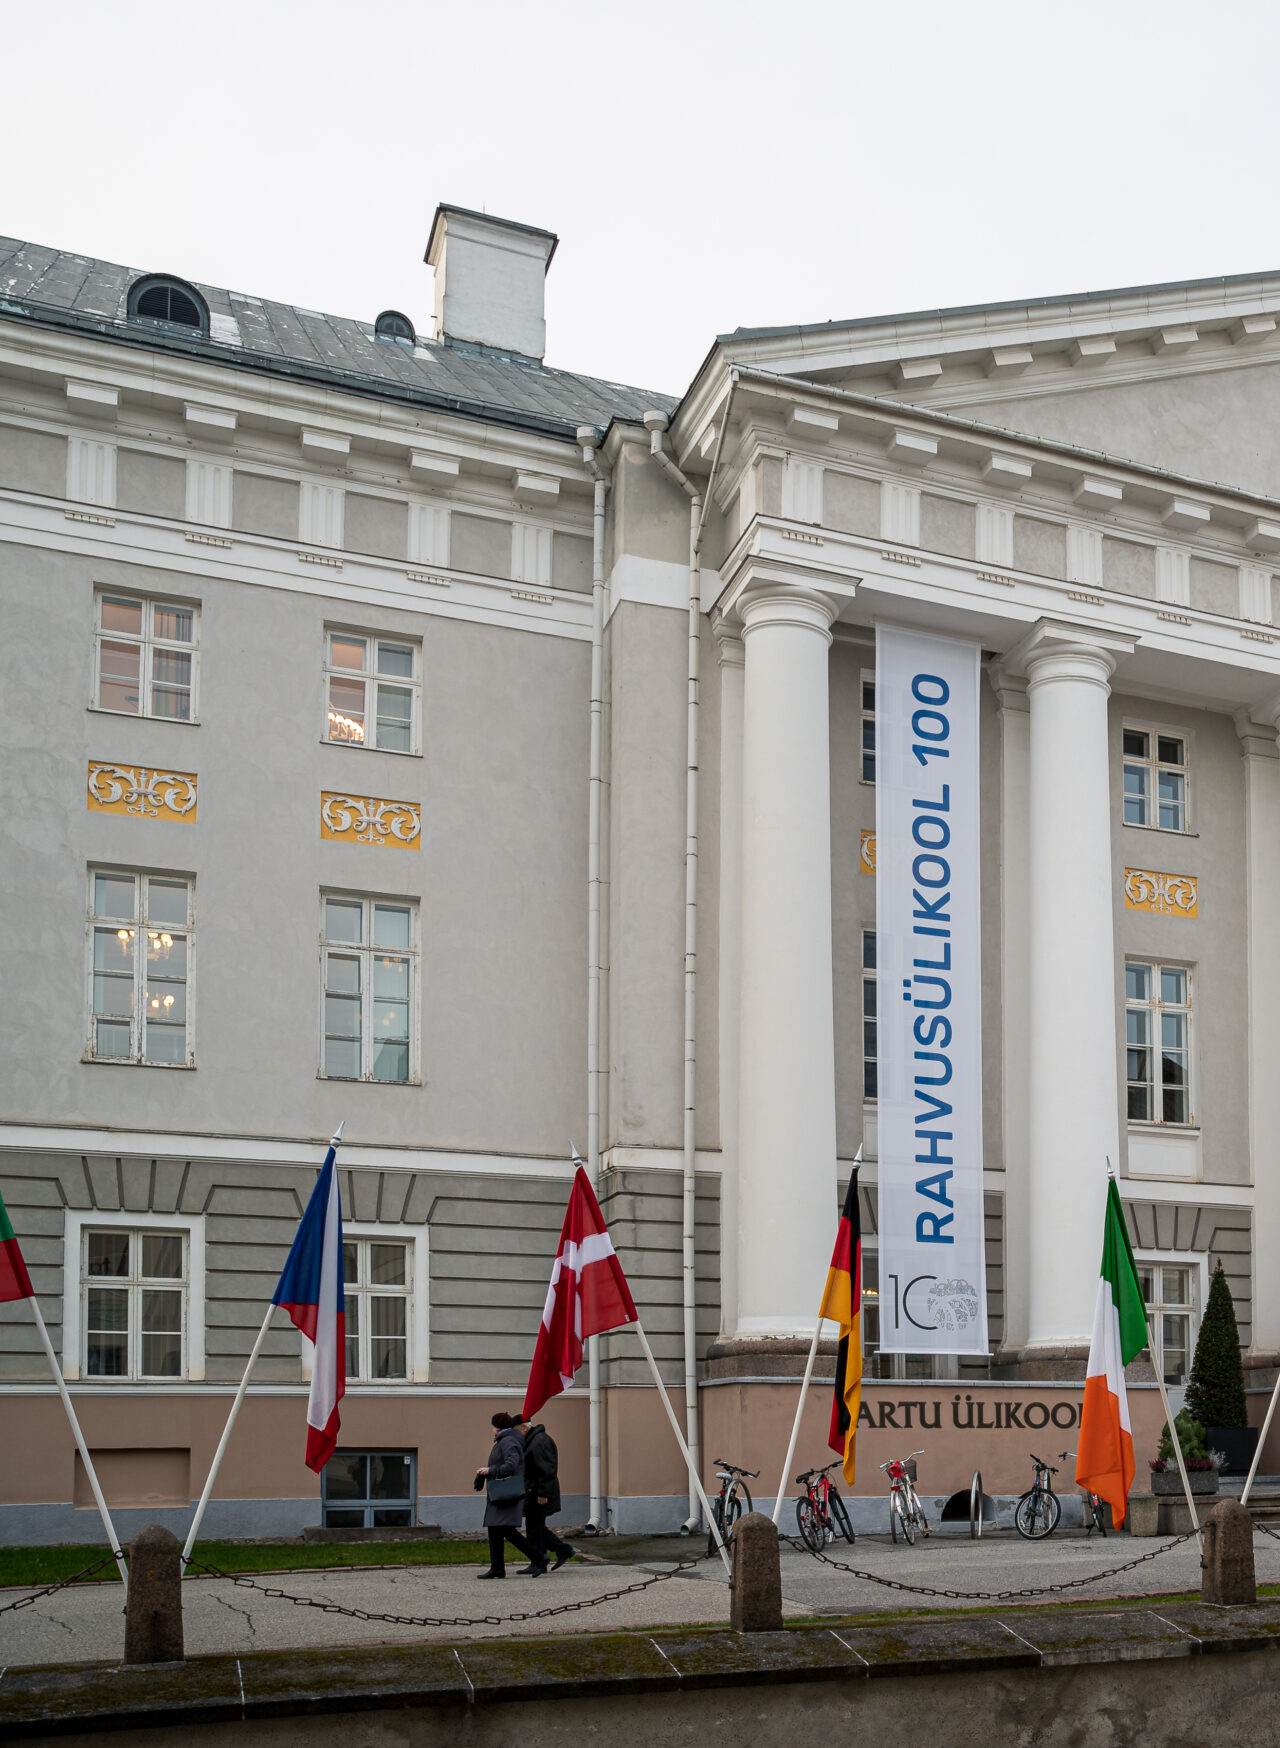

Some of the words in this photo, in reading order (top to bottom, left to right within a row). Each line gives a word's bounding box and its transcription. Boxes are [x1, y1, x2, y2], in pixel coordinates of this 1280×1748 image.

[911, 673, 950, 767] 100
[903, 783, 955, 1245] RAHVUSÜLIKOOL
[856, 1401, 942, 1429] ARTU
[951, 1394, 1085, 1430] ÜLIKOO
